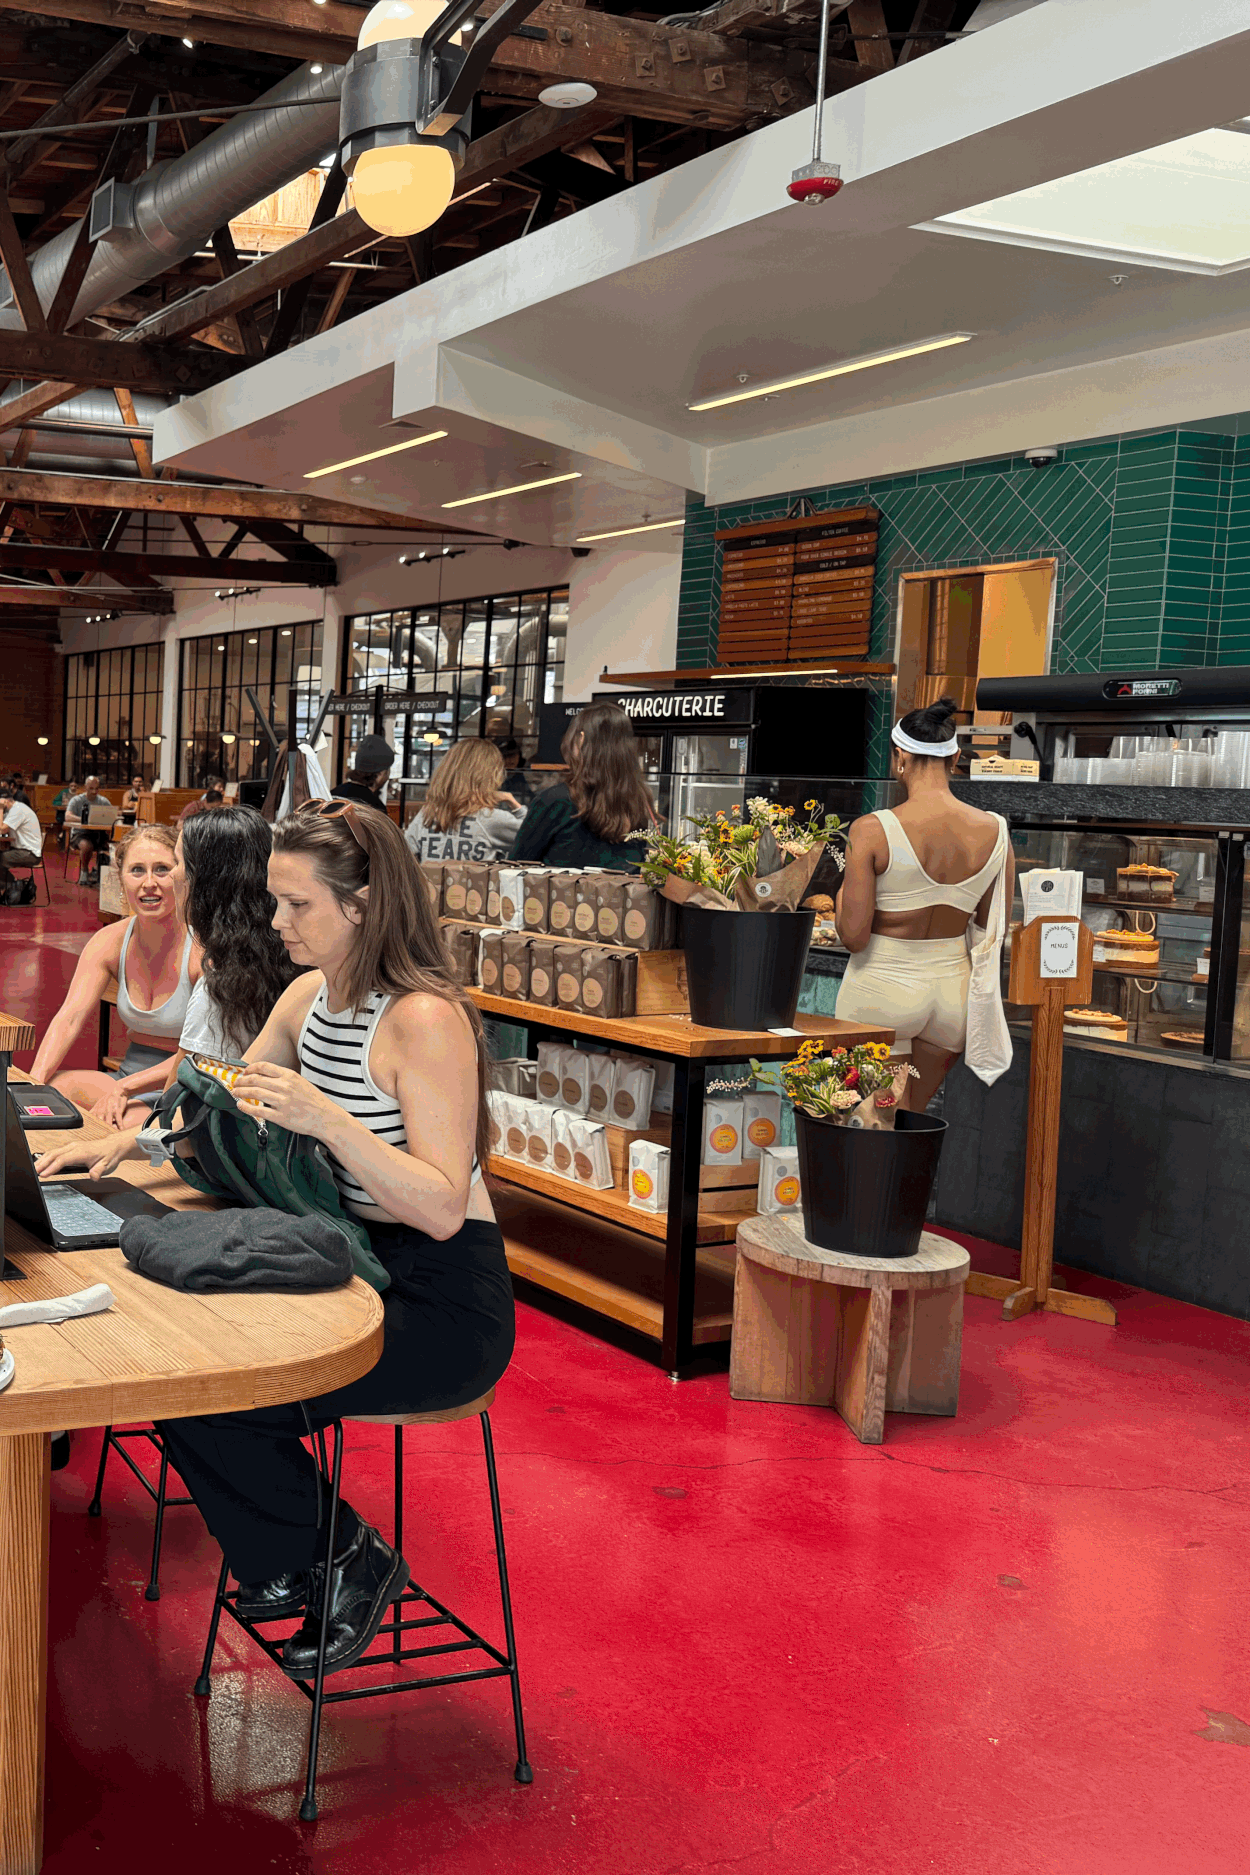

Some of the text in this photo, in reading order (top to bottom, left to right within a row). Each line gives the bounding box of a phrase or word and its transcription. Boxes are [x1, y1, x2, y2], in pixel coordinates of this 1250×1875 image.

[823, 178, 839, 186] FIRE
[335, 703, 345, 711] HERE
[351, 703, 371, 711] CHECKOUT
[385, 702, 398, 710] ORDER
[399, 701, 410, 710] HERE
[417, 700, 439, 709] CHECKOUT
